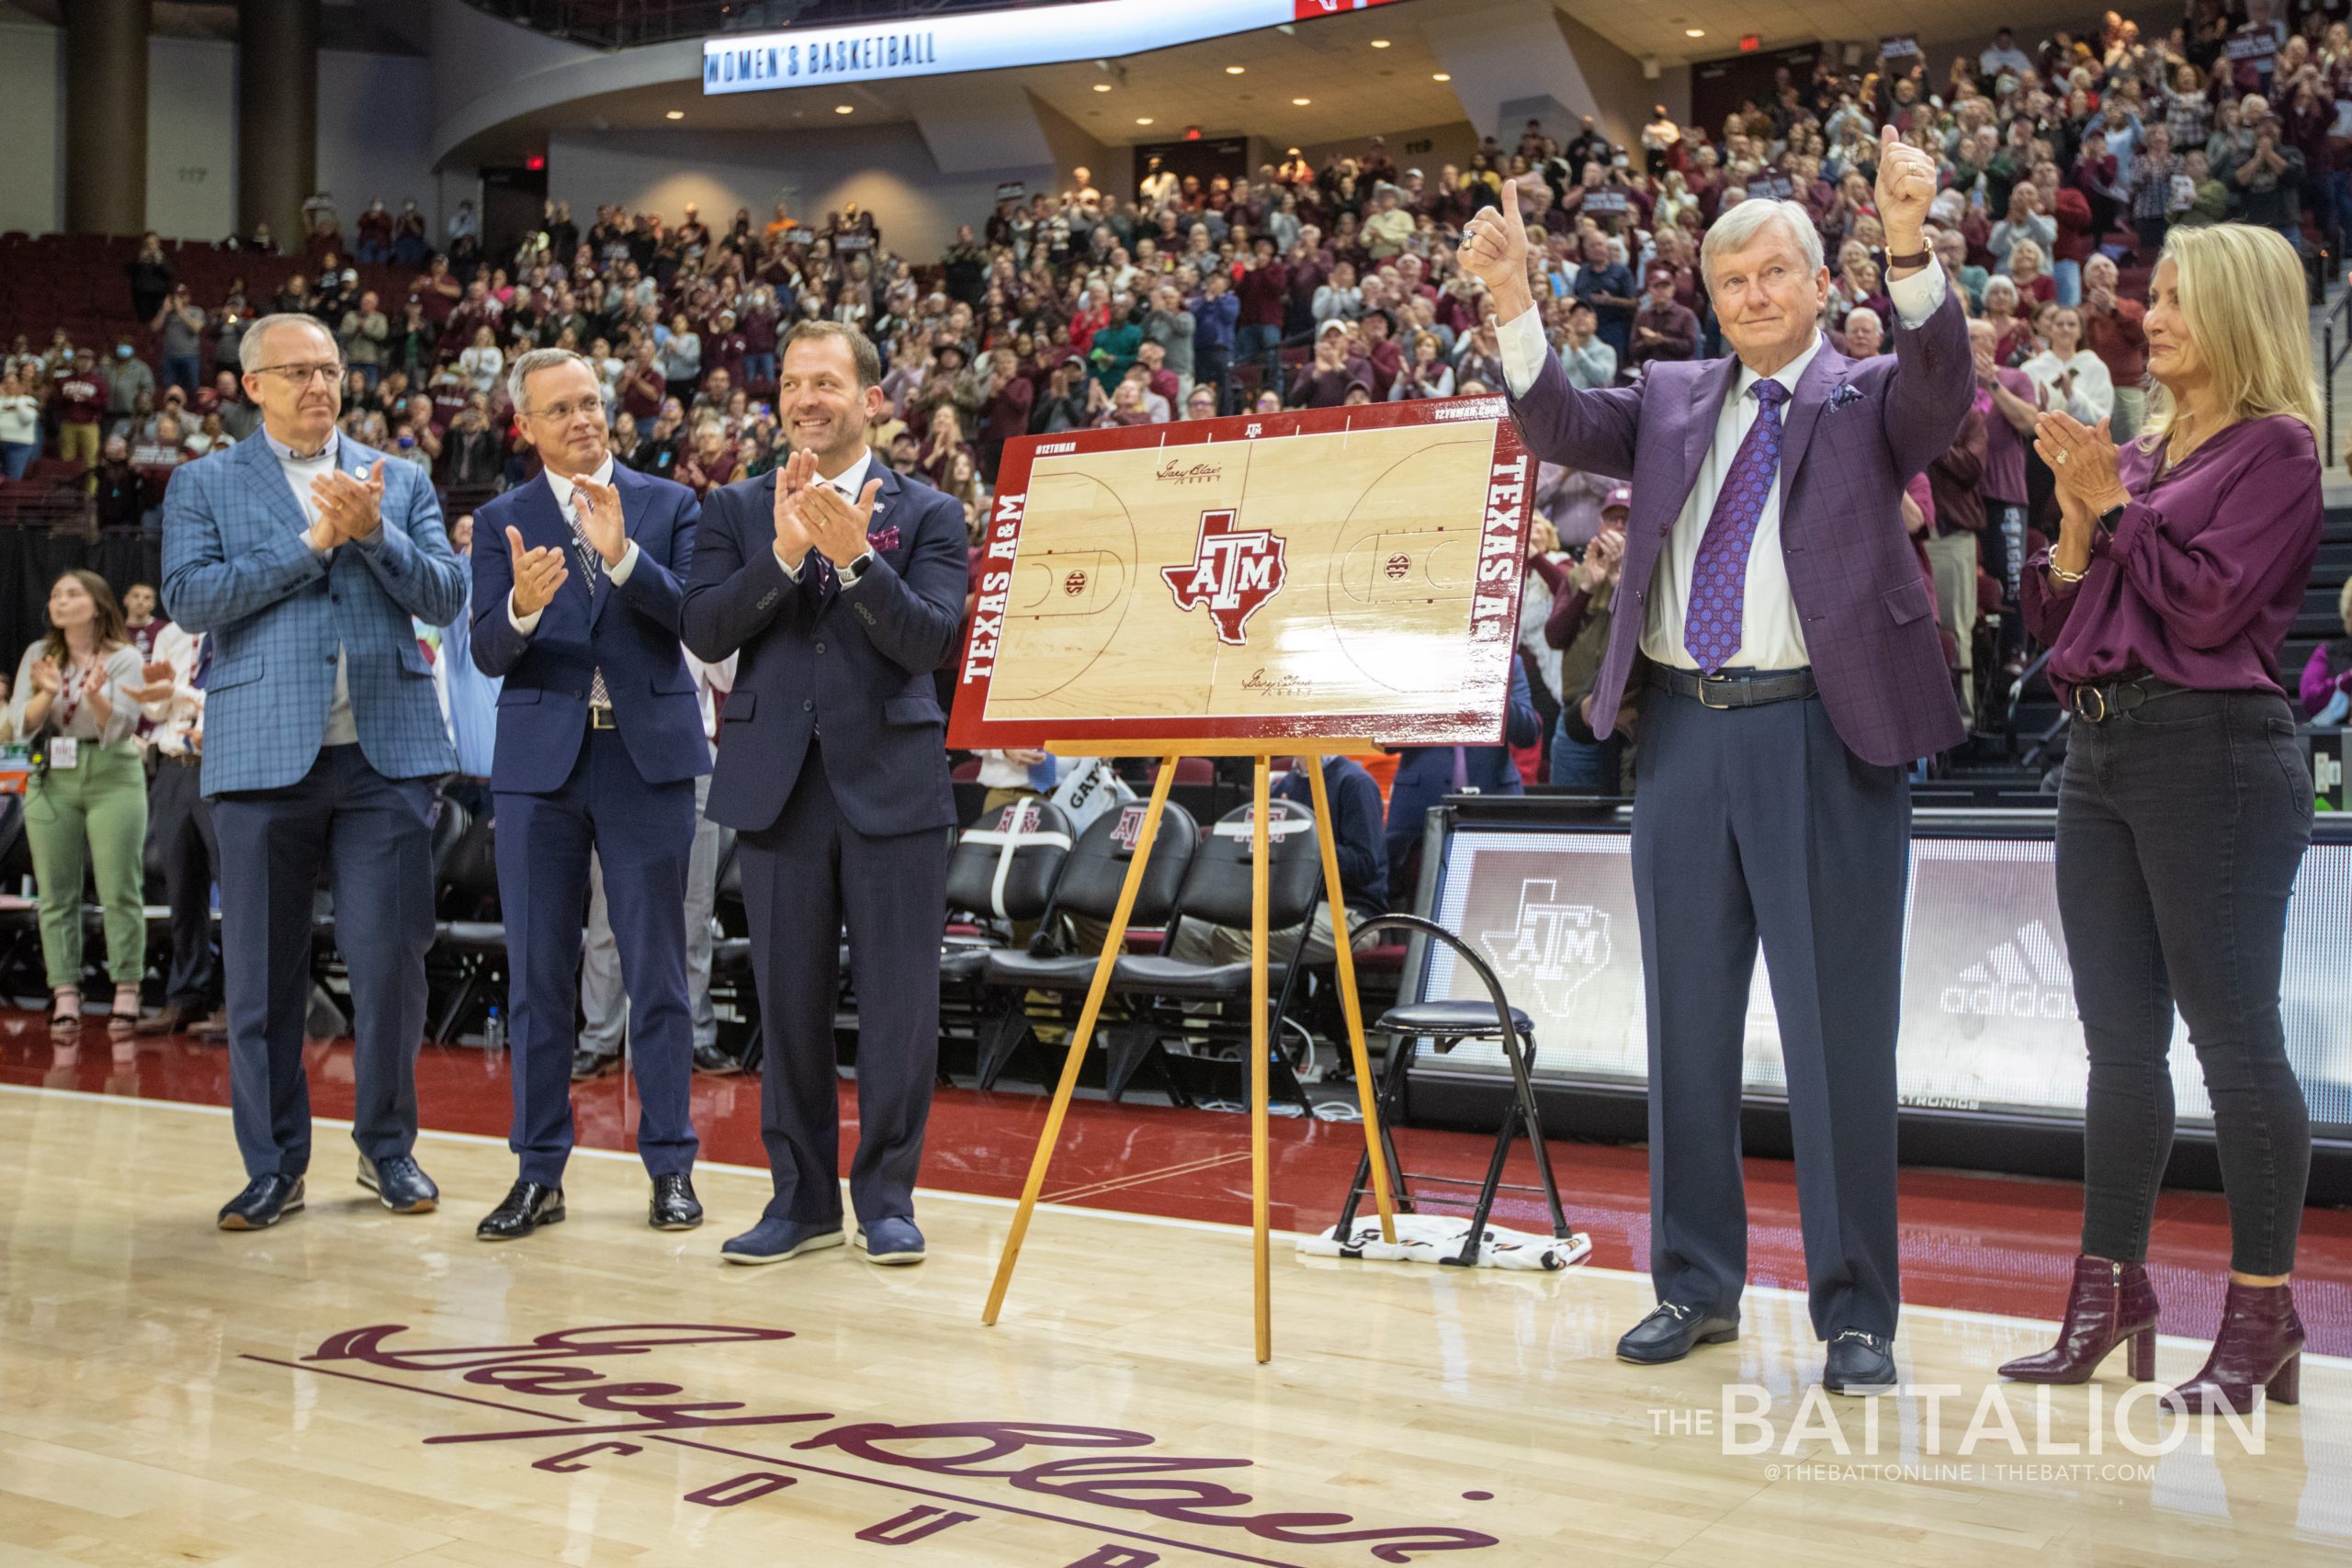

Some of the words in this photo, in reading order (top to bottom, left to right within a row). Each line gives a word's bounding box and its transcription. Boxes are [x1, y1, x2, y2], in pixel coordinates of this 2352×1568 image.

[704, 46, 799, 84] WOMEN'S
[808, 33, 936, 74] BASKETBALL
[1478, 455, 1527, 581] TEXAS
[963, 571, 1012, 683] TEXAS
[989, 493, 1025, 559] A&M
[1066, 572, 1085, 594] SEC
[1386, 555, 1409, 579] SEC
